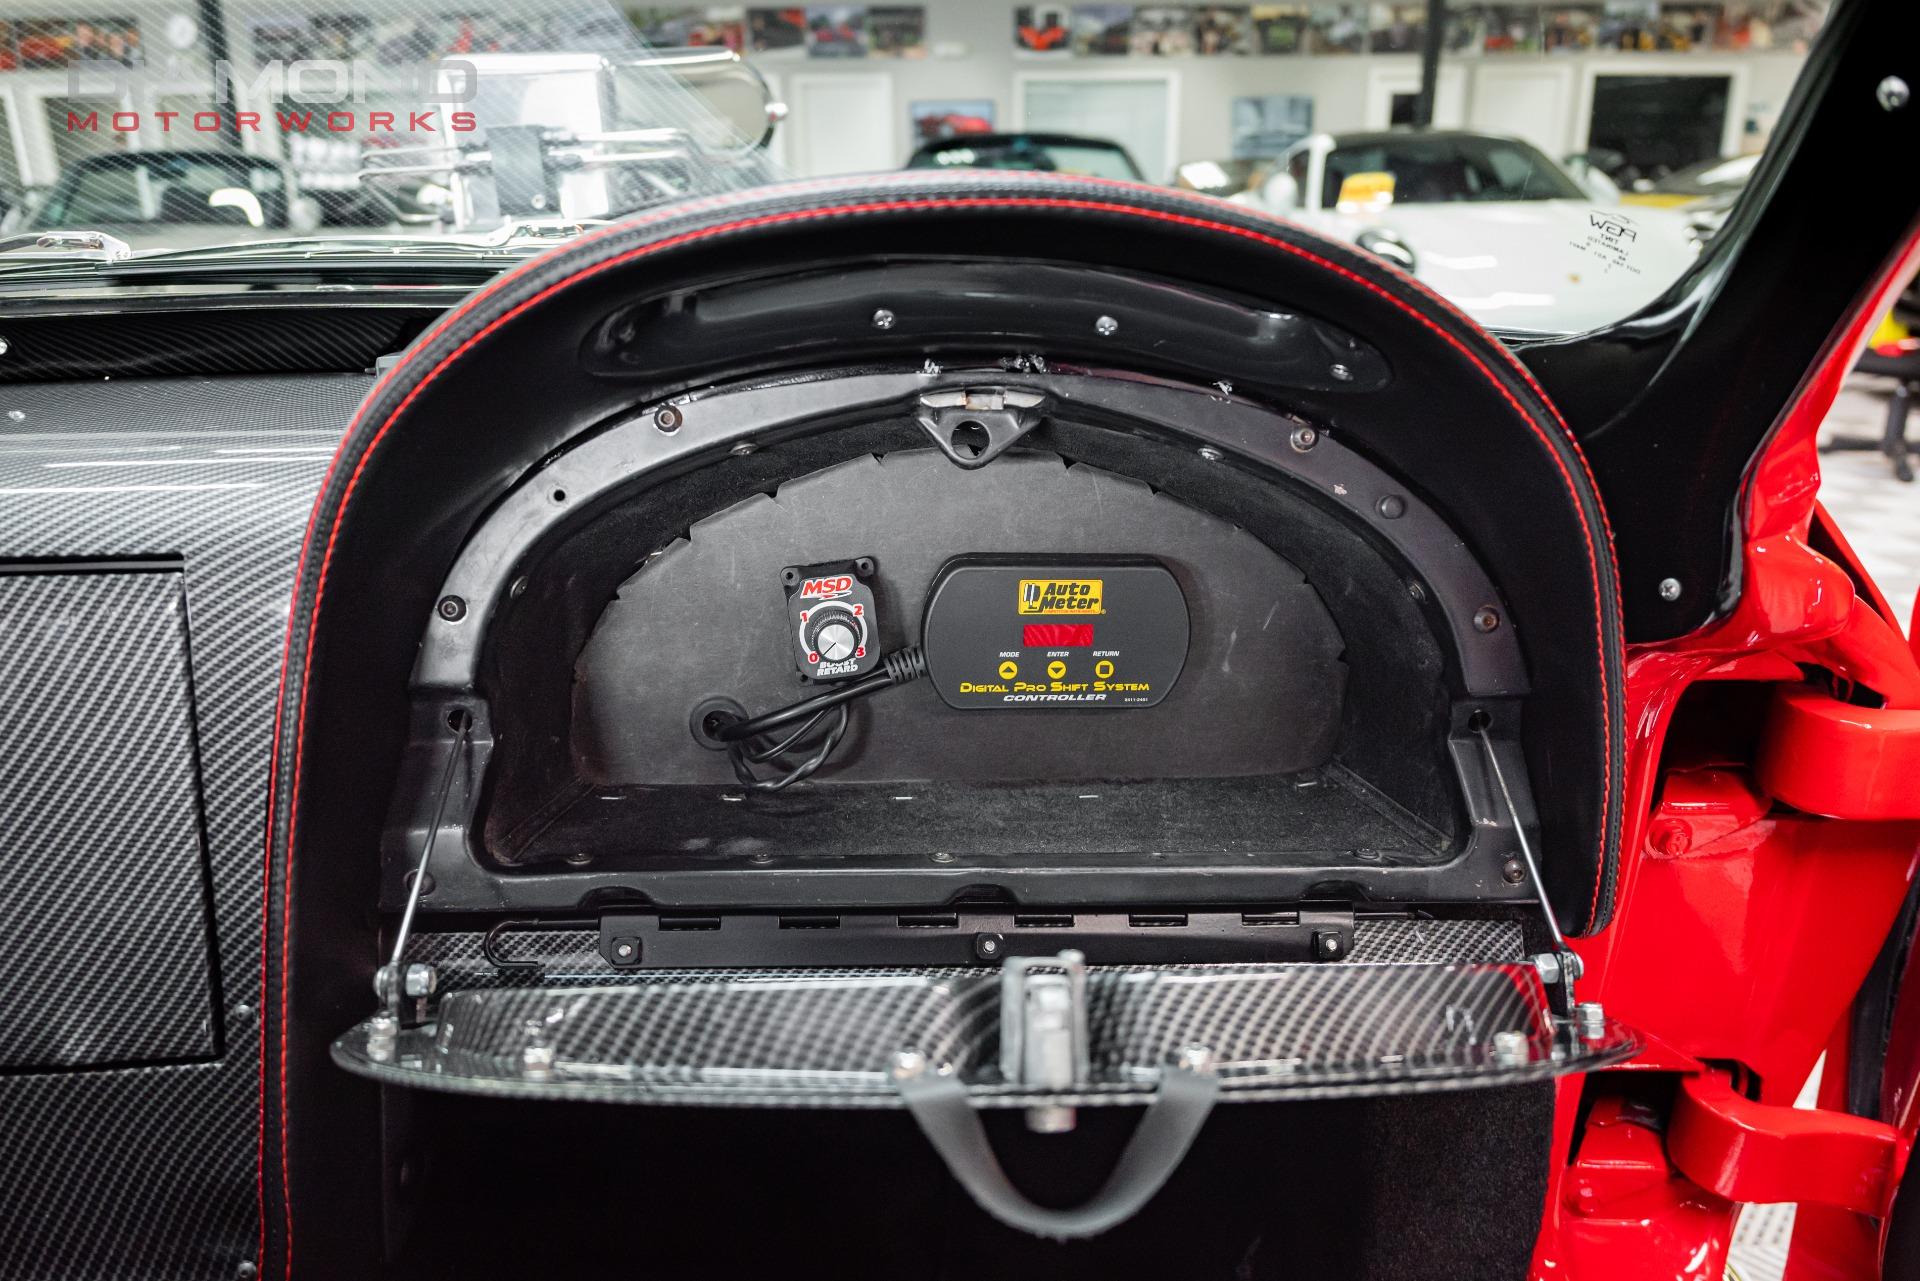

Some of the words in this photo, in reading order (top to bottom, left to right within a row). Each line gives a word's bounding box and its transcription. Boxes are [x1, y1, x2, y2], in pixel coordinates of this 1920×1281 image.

[801, 576, 853, 598] MSD
[1044, 583, 1091, 596] Auto
[1040, 597, 1100, 611] Meter
[853, 604, 864, 617] 2
[800, 611, 809, 623] 1
[808, 652, 819, 664] 0
[855, 646, 866, 658] 3
[817, 664, 858, 676] RETARD
[1003, 693, 1107, 702] CONTROLLER
